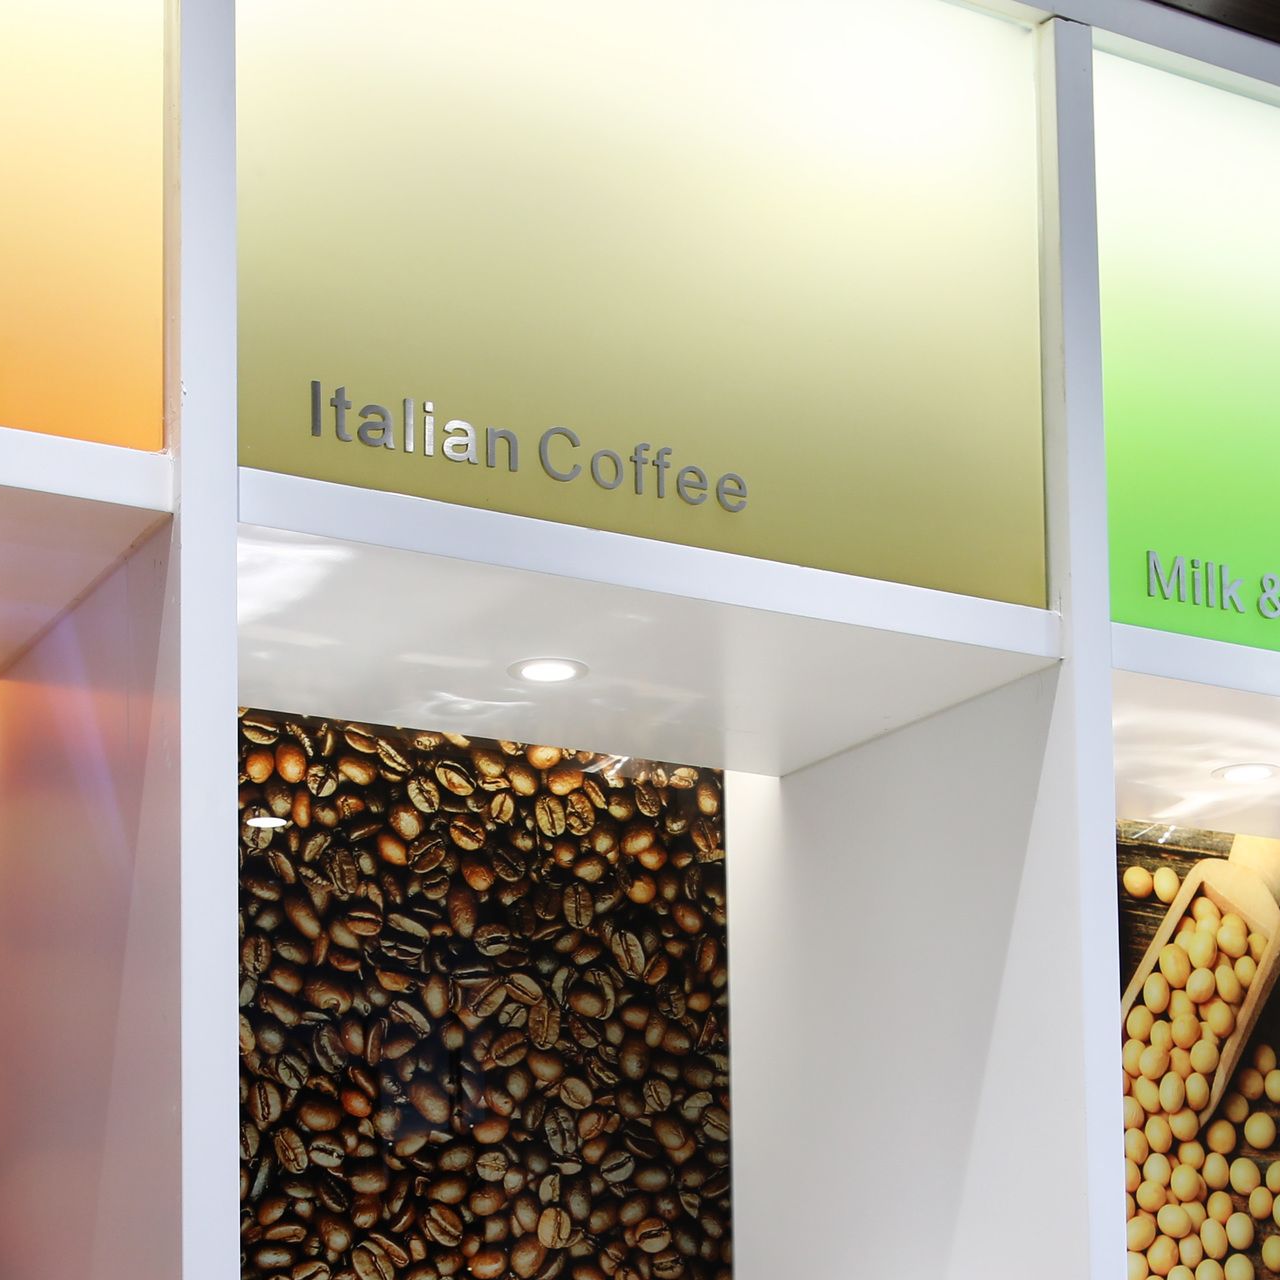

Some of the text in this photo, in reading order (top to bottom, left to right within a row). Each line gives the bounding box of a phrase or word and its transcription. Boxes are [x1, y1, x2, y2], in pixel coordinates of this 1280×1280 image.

[311, 379, 748, 513] Italian Coffee
[1146, 550, 1245, 614] Milk
